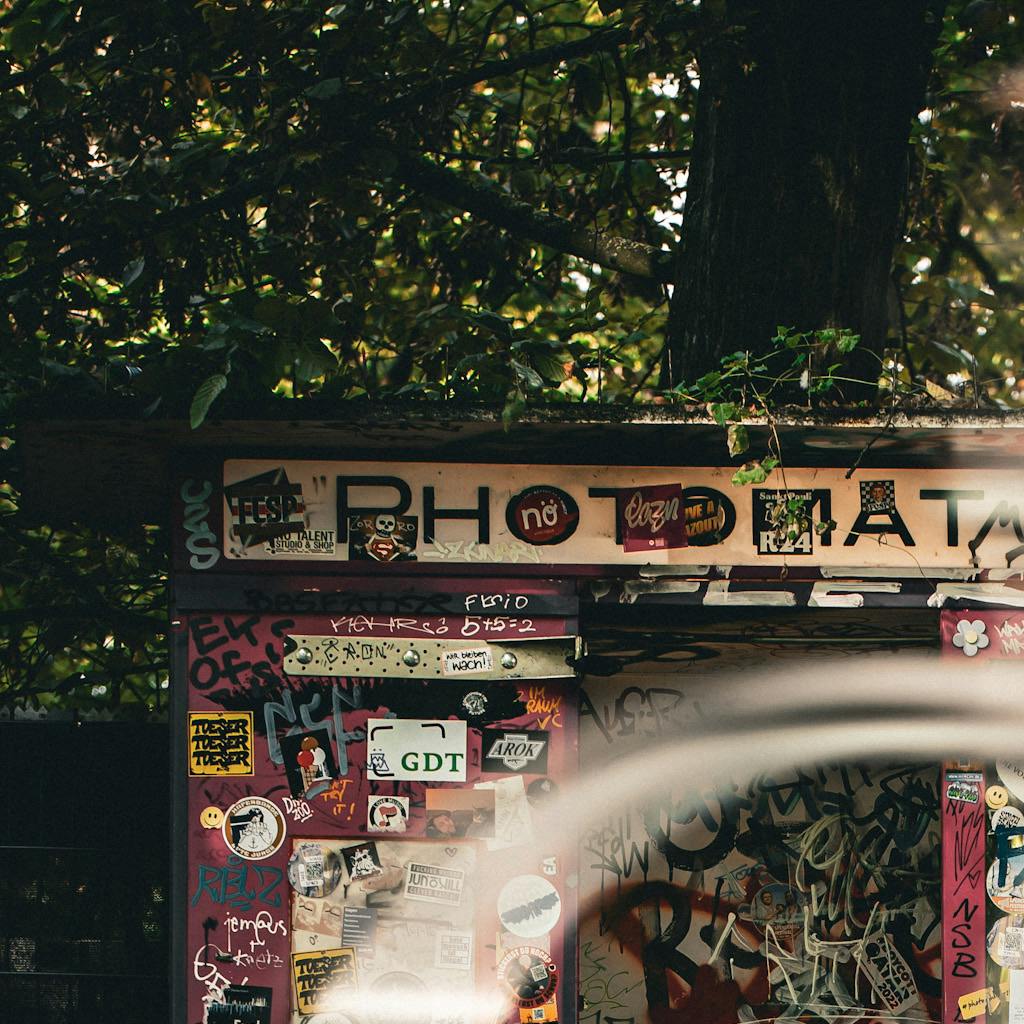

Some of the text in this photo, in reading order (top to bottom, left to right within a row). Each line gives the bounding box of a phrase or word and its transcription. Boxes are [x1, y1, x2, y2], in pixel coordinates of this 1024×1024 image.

[297, 531, 335, 541] TALENT
[276, 540, 303, 549] STUDIO
[313, 540, 335, 549] SHOP
[401, 752, 464, 772] GDT
[878, 983, 899, 1009] 2022
